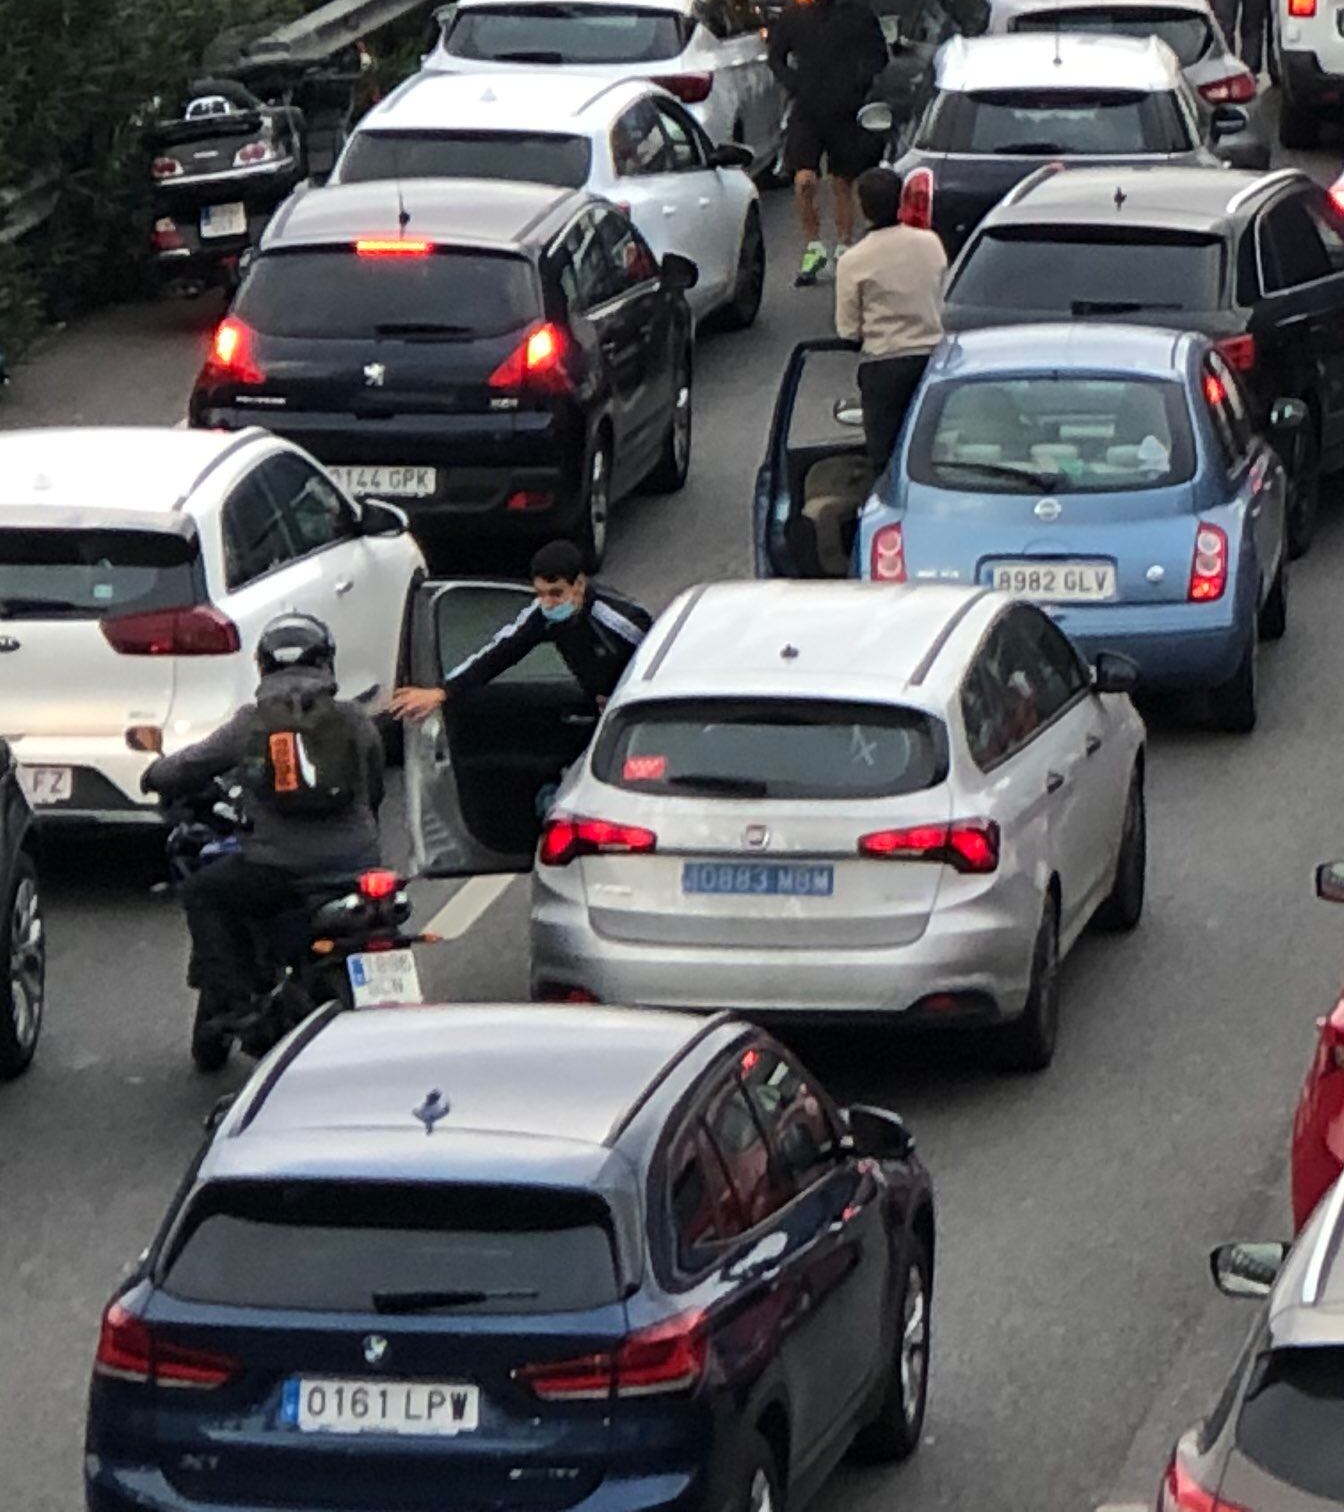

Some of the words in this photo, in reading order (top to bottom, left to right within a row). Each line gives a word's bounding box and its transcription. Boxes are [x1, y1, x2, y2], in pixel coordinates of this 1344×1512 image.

[1064, 567, 1108, 592] GLV
[306, 1386, 391, 1419] 0161
[404, 1387, 468, 1421] LPW
